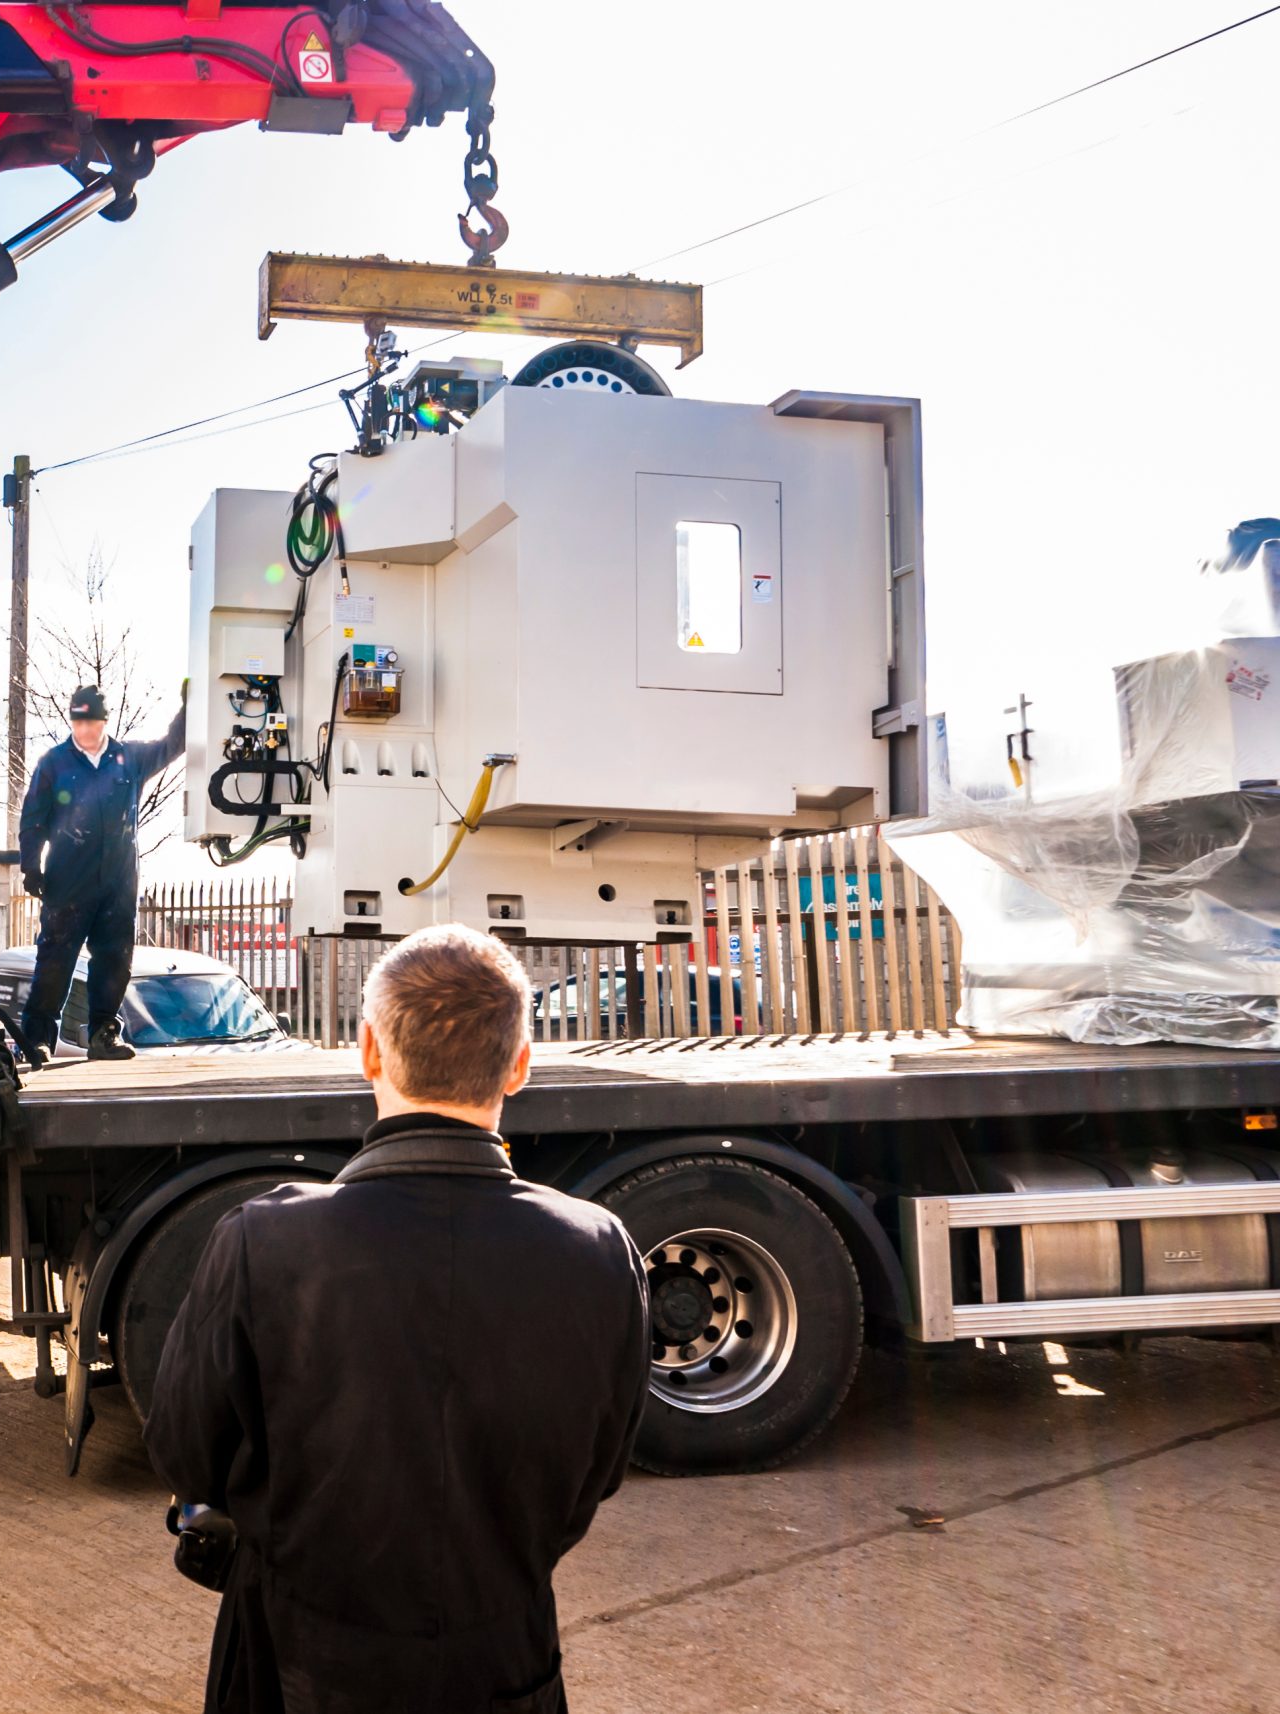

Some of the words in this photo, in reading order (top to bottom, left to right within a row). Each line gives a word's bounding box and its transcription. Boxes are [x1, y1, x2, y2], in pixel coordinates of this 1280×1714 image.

[457, 291, 483, 303] WLL
[488, 293, 512, 305] 7.5t
[1164, 1250, 1202, 1260] DAF
